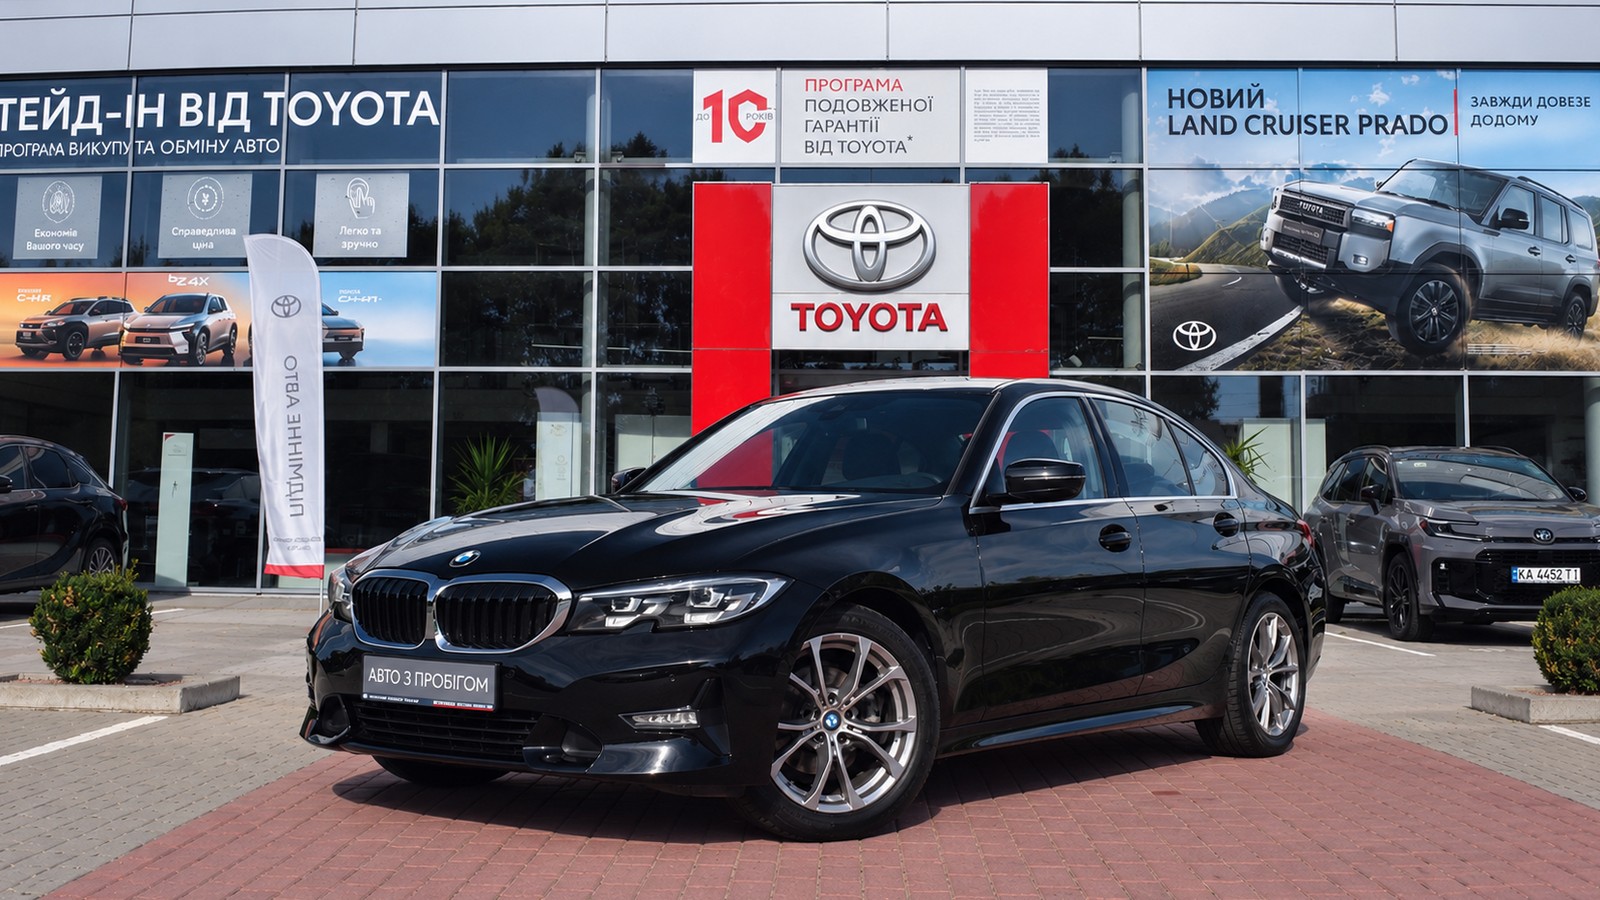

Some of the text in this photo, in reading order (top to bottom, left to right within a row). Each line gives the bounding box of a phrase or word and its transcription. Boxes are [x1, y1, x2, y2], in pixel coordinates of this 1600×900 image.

[805, 78, 904, 92] ПРОГРАМА
[1167, 83, 1266, 109] НОВИЙ
[1470, 95, 1591, 110] ЗАВЖДИ ДОВЕЗЕ
[179, 91, 251, 134] ВІД
[263, 90, 440, 127] TOYOTA
[805, 95, 934, 115] ПОДОВЖЕНОЇ
[696, 89, 774, 144] ДО 10 РОКІВ
[805, 116, 881, 133] ГАРАНТІЇ
[1168, 113, 1449, 136] LAND CRUISER PRADO
[1470, 113, 1539, 128] ДОДОМУ
[69, 141, 131, 156] ВИКУПУ
[135, 140, 156, 155] ТА
[160, 138, 230, 155] ОБМІНУ
[234, 138, 280, 154] АВТО
[804, 140, 833, 156] ВІД
[171, 226, 237, 238] Справедлива
[339, 226, 382, 236] Легко та
[341, 241, 379, 251] зручно
[790, 302, 949, 333] TOYOTA
[1518, 568, 1533, 580] KA
[1536, 568, 1563, 580] 4452
[368, 667, 489, 693] АВТО З ПРОБІГОМ
